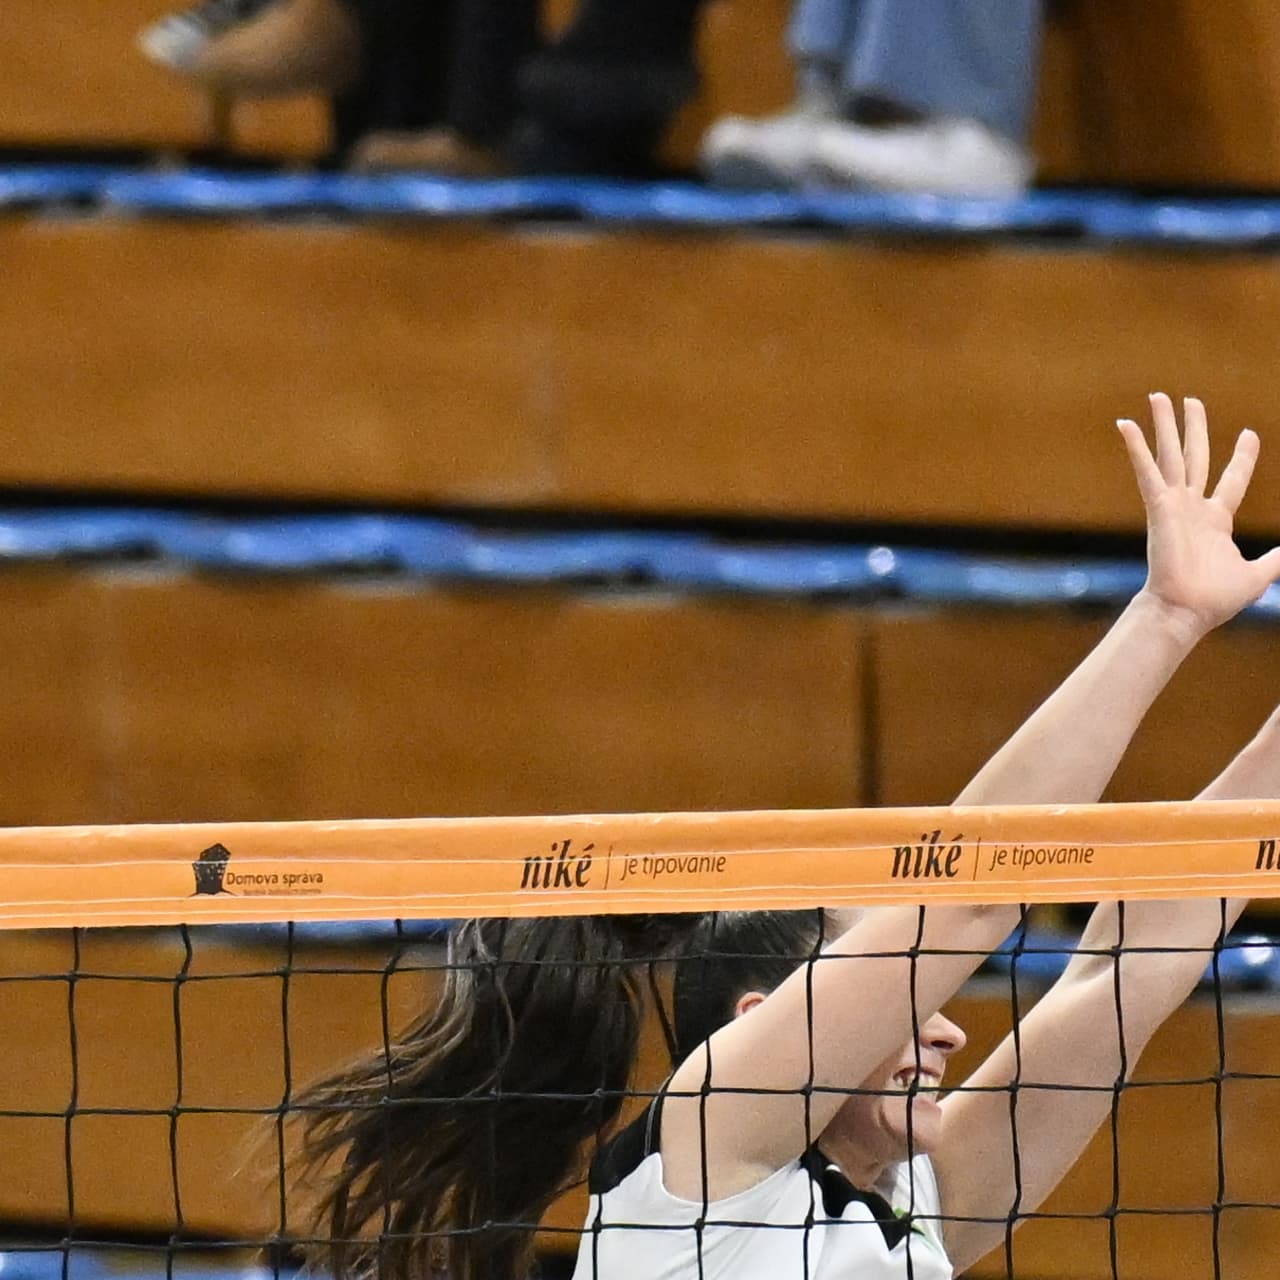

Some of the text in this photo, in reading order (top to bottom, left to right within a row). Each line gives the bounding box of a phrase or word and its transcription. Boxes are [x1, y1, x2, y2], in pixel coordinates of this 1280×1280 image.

[519, 838, 595, 889] niké
[619, 852, 727, 882] je tipovanie
[891, 829, 964, 879] niké
[988, 843, 1095, 872] je tipovanie
